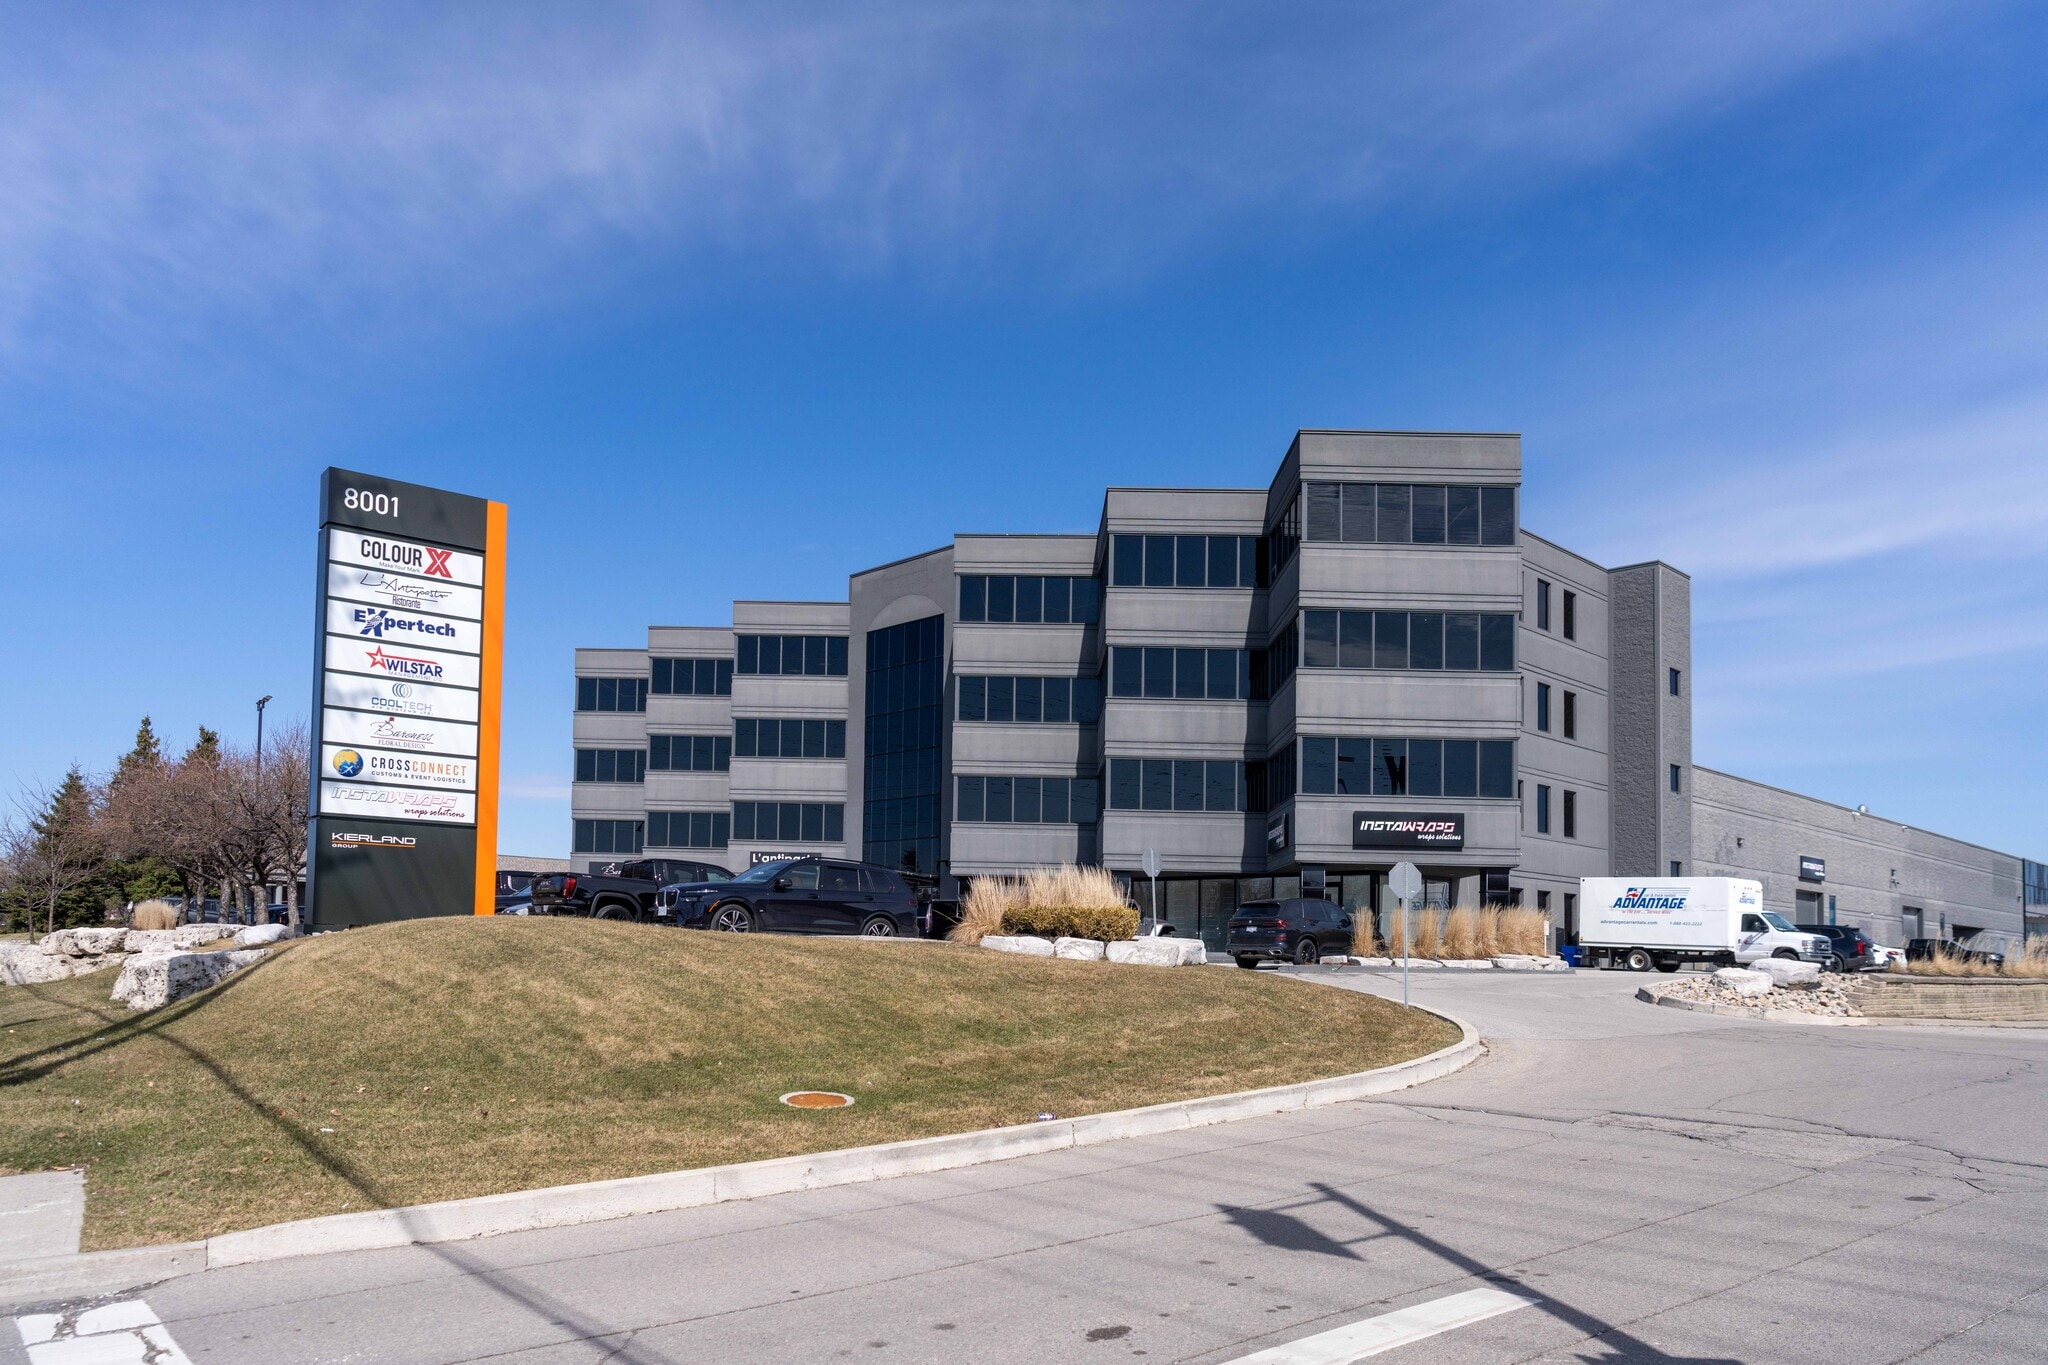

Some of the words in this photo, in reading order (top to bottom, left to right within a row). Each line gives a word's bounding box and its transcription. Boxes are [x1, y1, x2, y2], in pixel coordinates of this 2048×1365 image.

[344, 488, 399, 518] 8001
[361, 539, 422, 567] COLOUR
[424, 547, 453, 578] X
[392, 595, 421, 609] Ristorante
[386, 659, 443, 677] WILSTAR
[388, 671, 431, 681] MANAGEMENT
[371, 697, 432, 712] COOLTECH
[370, 720, 434, 741] Baroness
[378, 739, 401, 747] FLORAL
[371, 770, 402, 778] CUSTOMS
[433, 776, 466, 784] LOGISTICS
[404, 808, 428, 818] wraps
[429, 808, 466, 818] solutions
[332, 832, 416, 846] KIERLAND
[1417, 833, 1435, 841] wraps
[1436, 833, 1461, 841] solutions
[1613, 888, 1686, 909] ADVANTAGE
